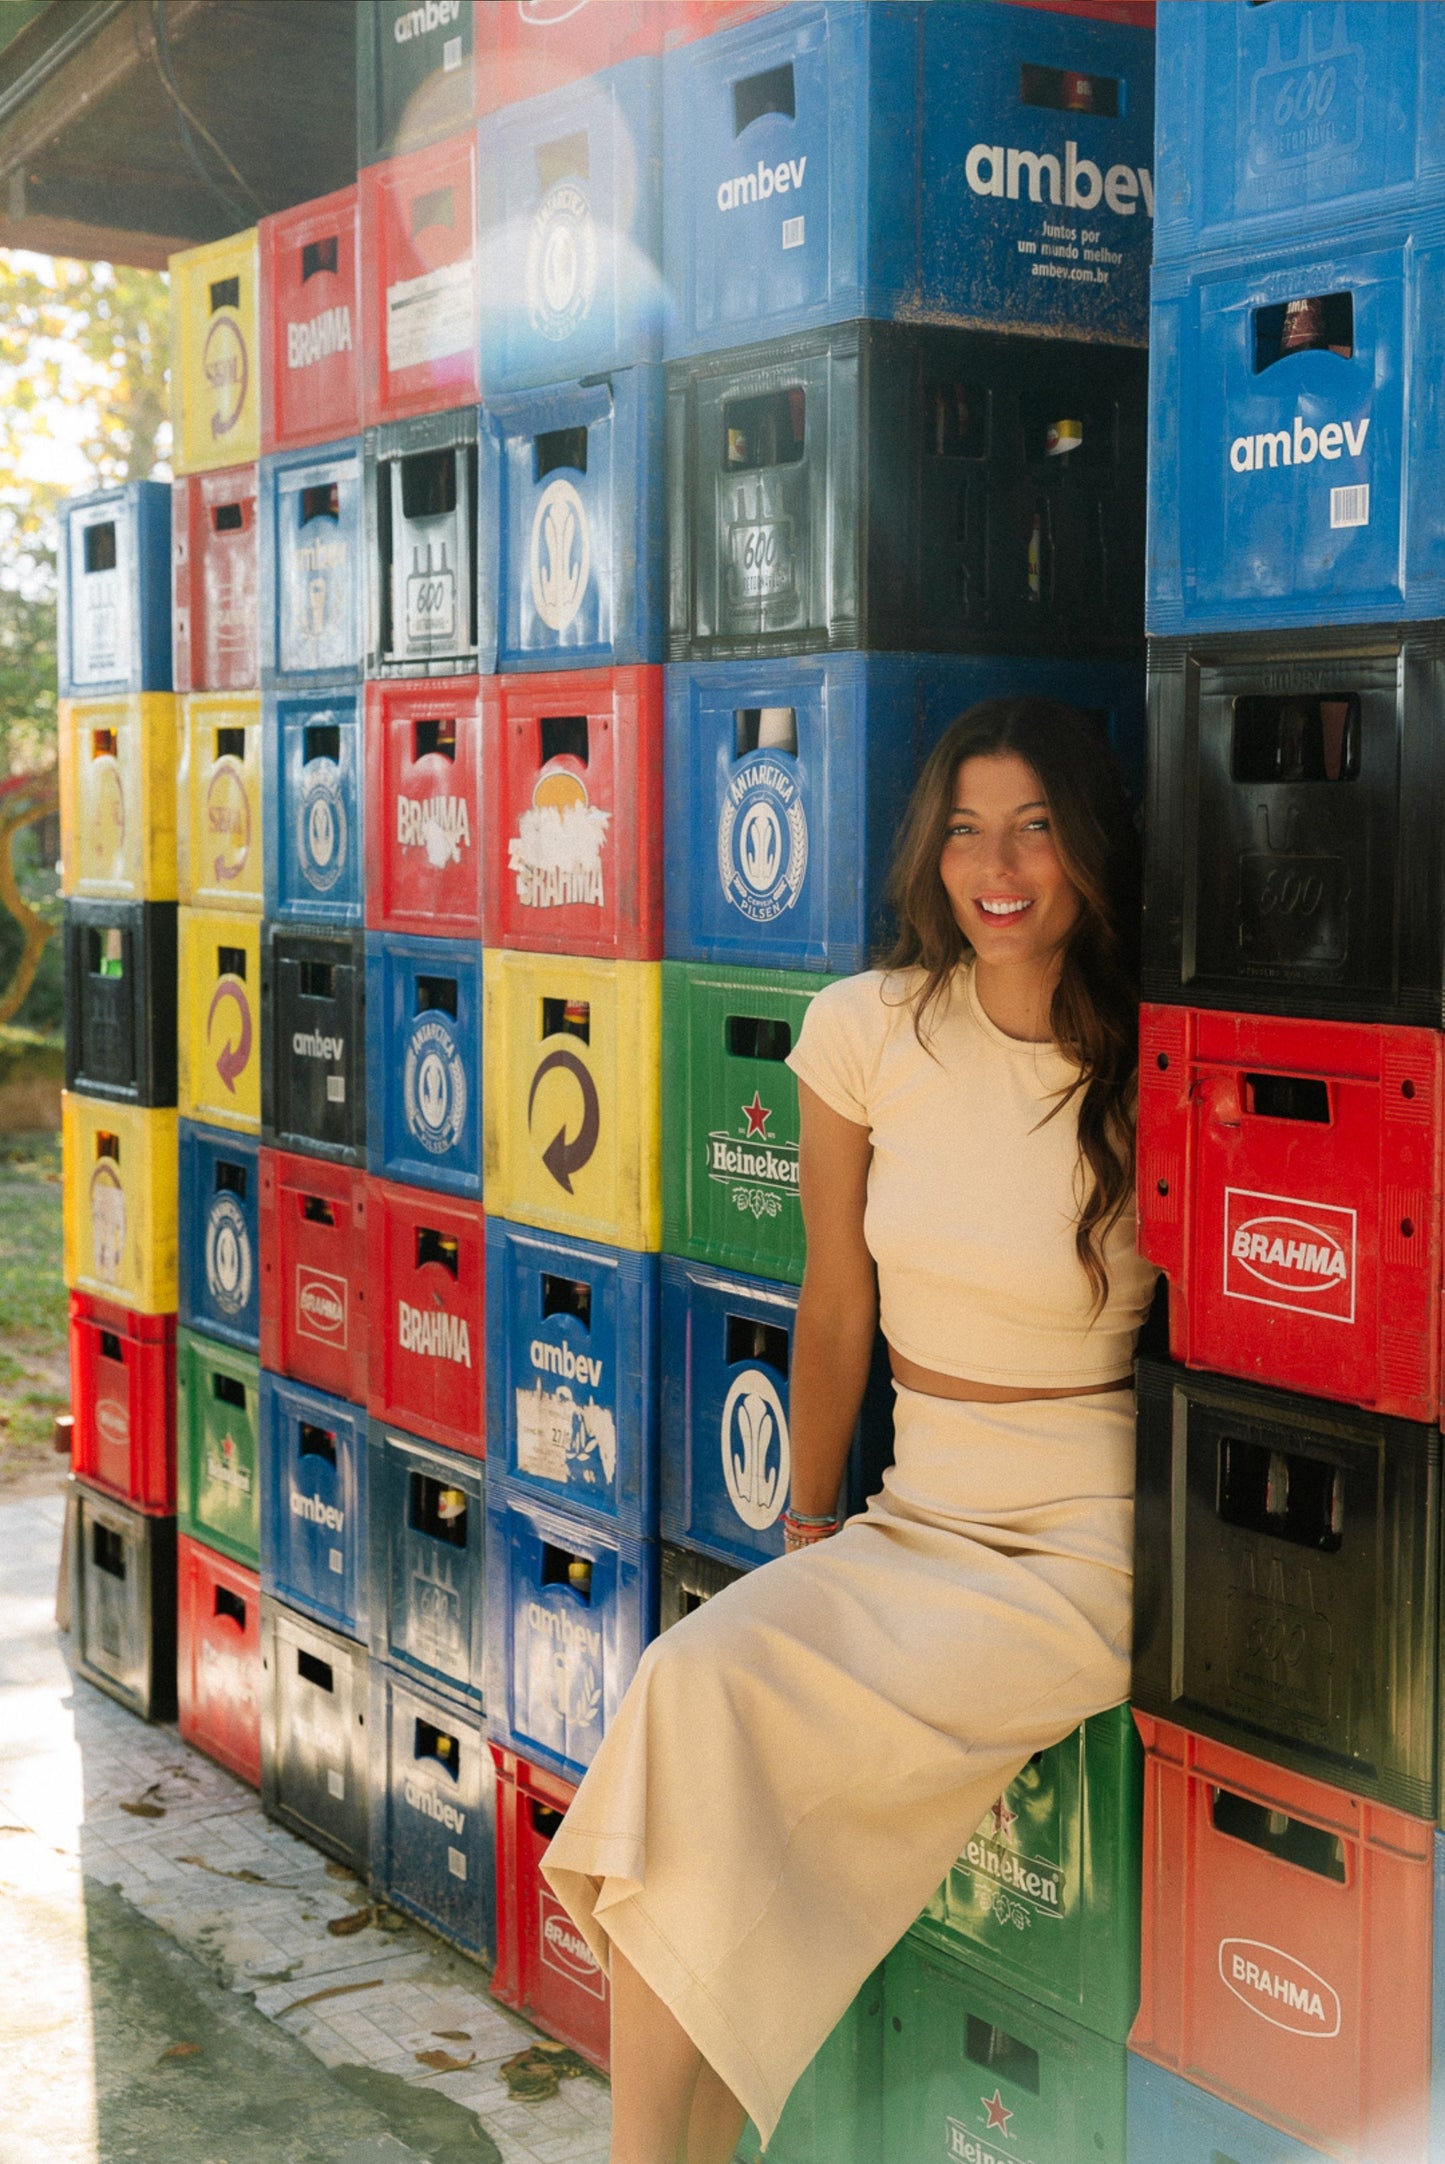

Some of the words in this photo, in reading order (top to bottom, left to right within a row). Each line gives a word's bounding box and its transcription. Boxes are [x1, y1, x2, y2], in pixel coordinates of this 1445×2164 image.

[394, 0, 460, 43] ambev
[1273, 66, 1337, 126] 600
[717, 156, 807, 211] ambev
[965, 140, 1155, 218] ambev
[1017, 240, 1036, 255] um
[1041, 244, 1079, 260] mundo
[1083, 248, 1123, 265] melhor
[1041, 221, 1076, 241] Juntos
[1081, 229, 1101, 245] por
[1032, 263, 1109, 284] ambev.com.br
[287, 304, 352, 369] BRAHMA
[1230, 416, 1370, 473] ambev
[744, 530, 779, 570] 600
[417, 581, 443, 613] 600
[730, 764, 795, 805] ANTARCTICA
[741, 900, 781, 919] PILSEN
[293, 1028, 343, 1061] ambev
[1231, 1230, 1347, 1280] BRAHMA
[398, 1299, 472, 1369] BRAHMA
[530, 1340, 603, 1388] ambev
[290, 1491, 344, 1533] ambev
[528, 1602, 601, 1658] ambev
[405, 1779, 466, 1836] ambev
[961, 1839, 1058, 1905] eineken
[1232, 1954, 1326, 2022] BRAHMA
